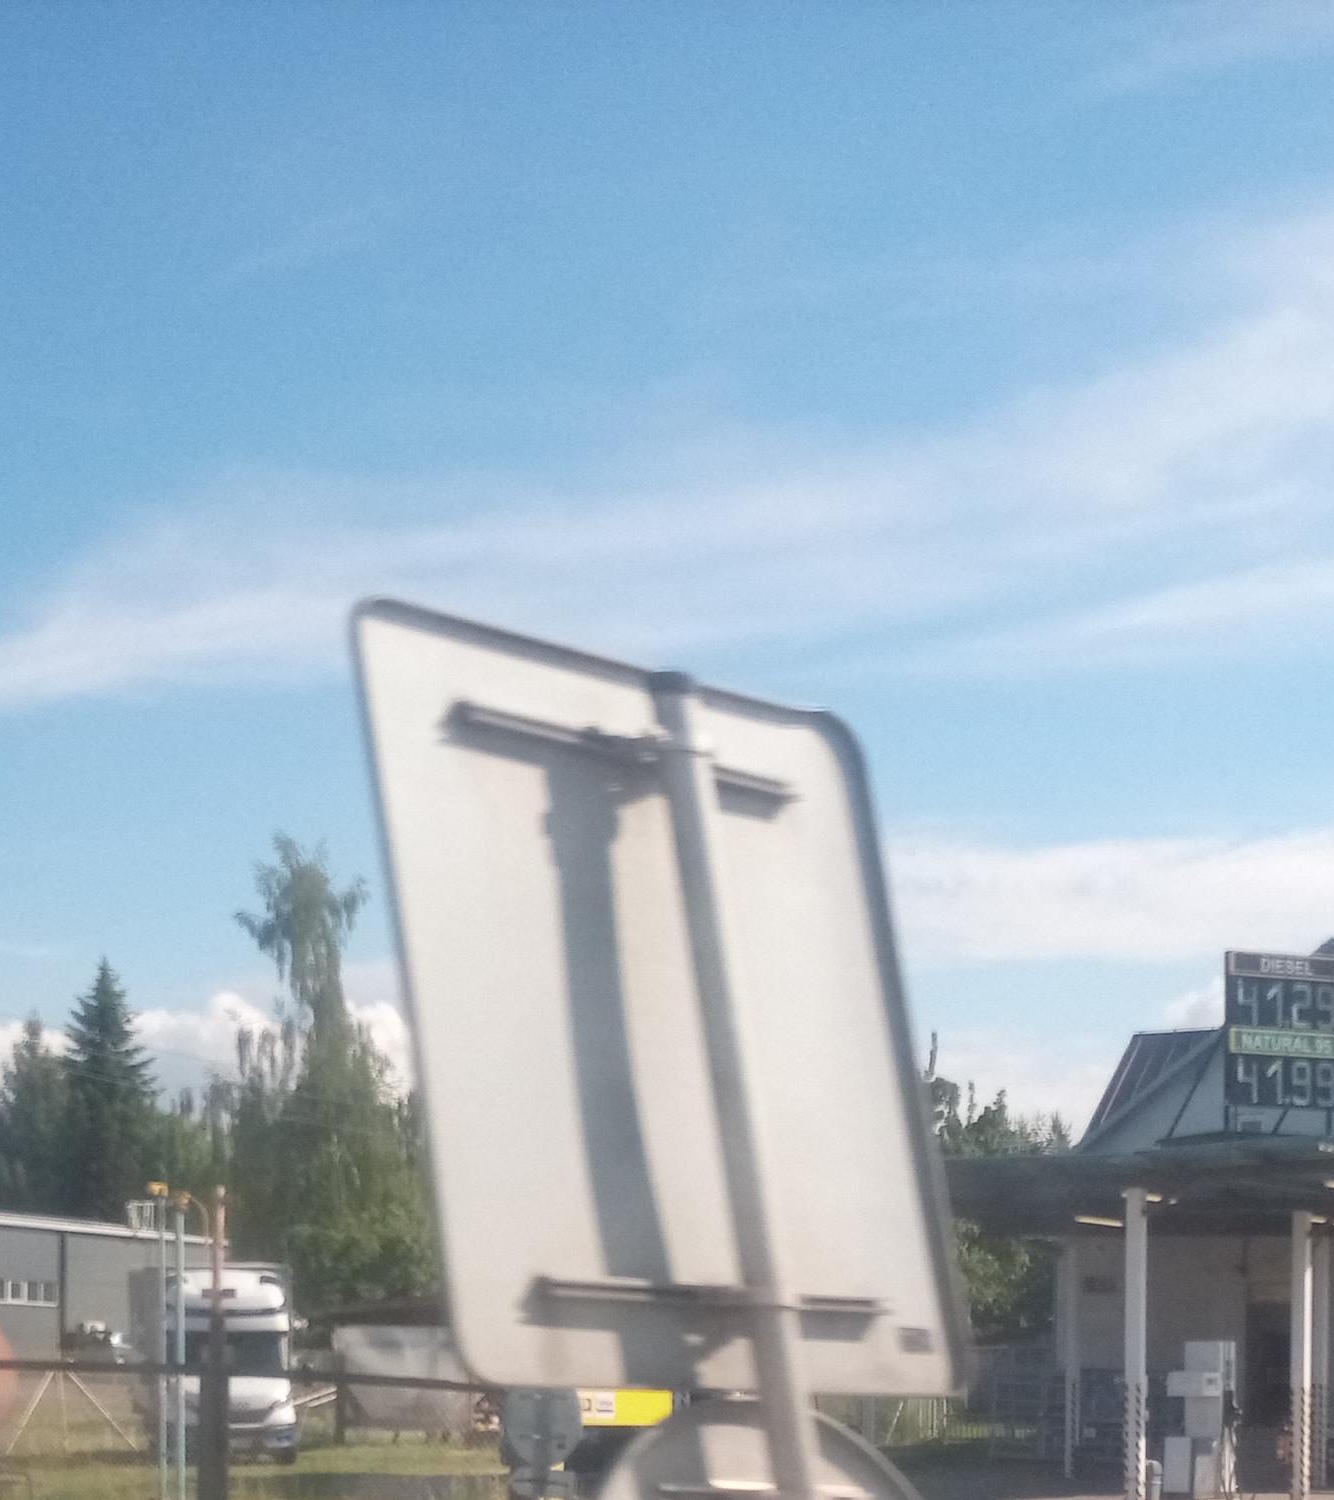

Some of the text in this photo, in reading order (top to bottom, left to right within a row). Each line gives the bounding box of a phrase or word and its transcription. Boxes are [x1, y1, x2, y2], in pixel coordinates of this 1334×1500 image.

[1260, 958, 1314, 976] DIESEL
[1241, 1032, 1333, 1052] NATURAL 95
